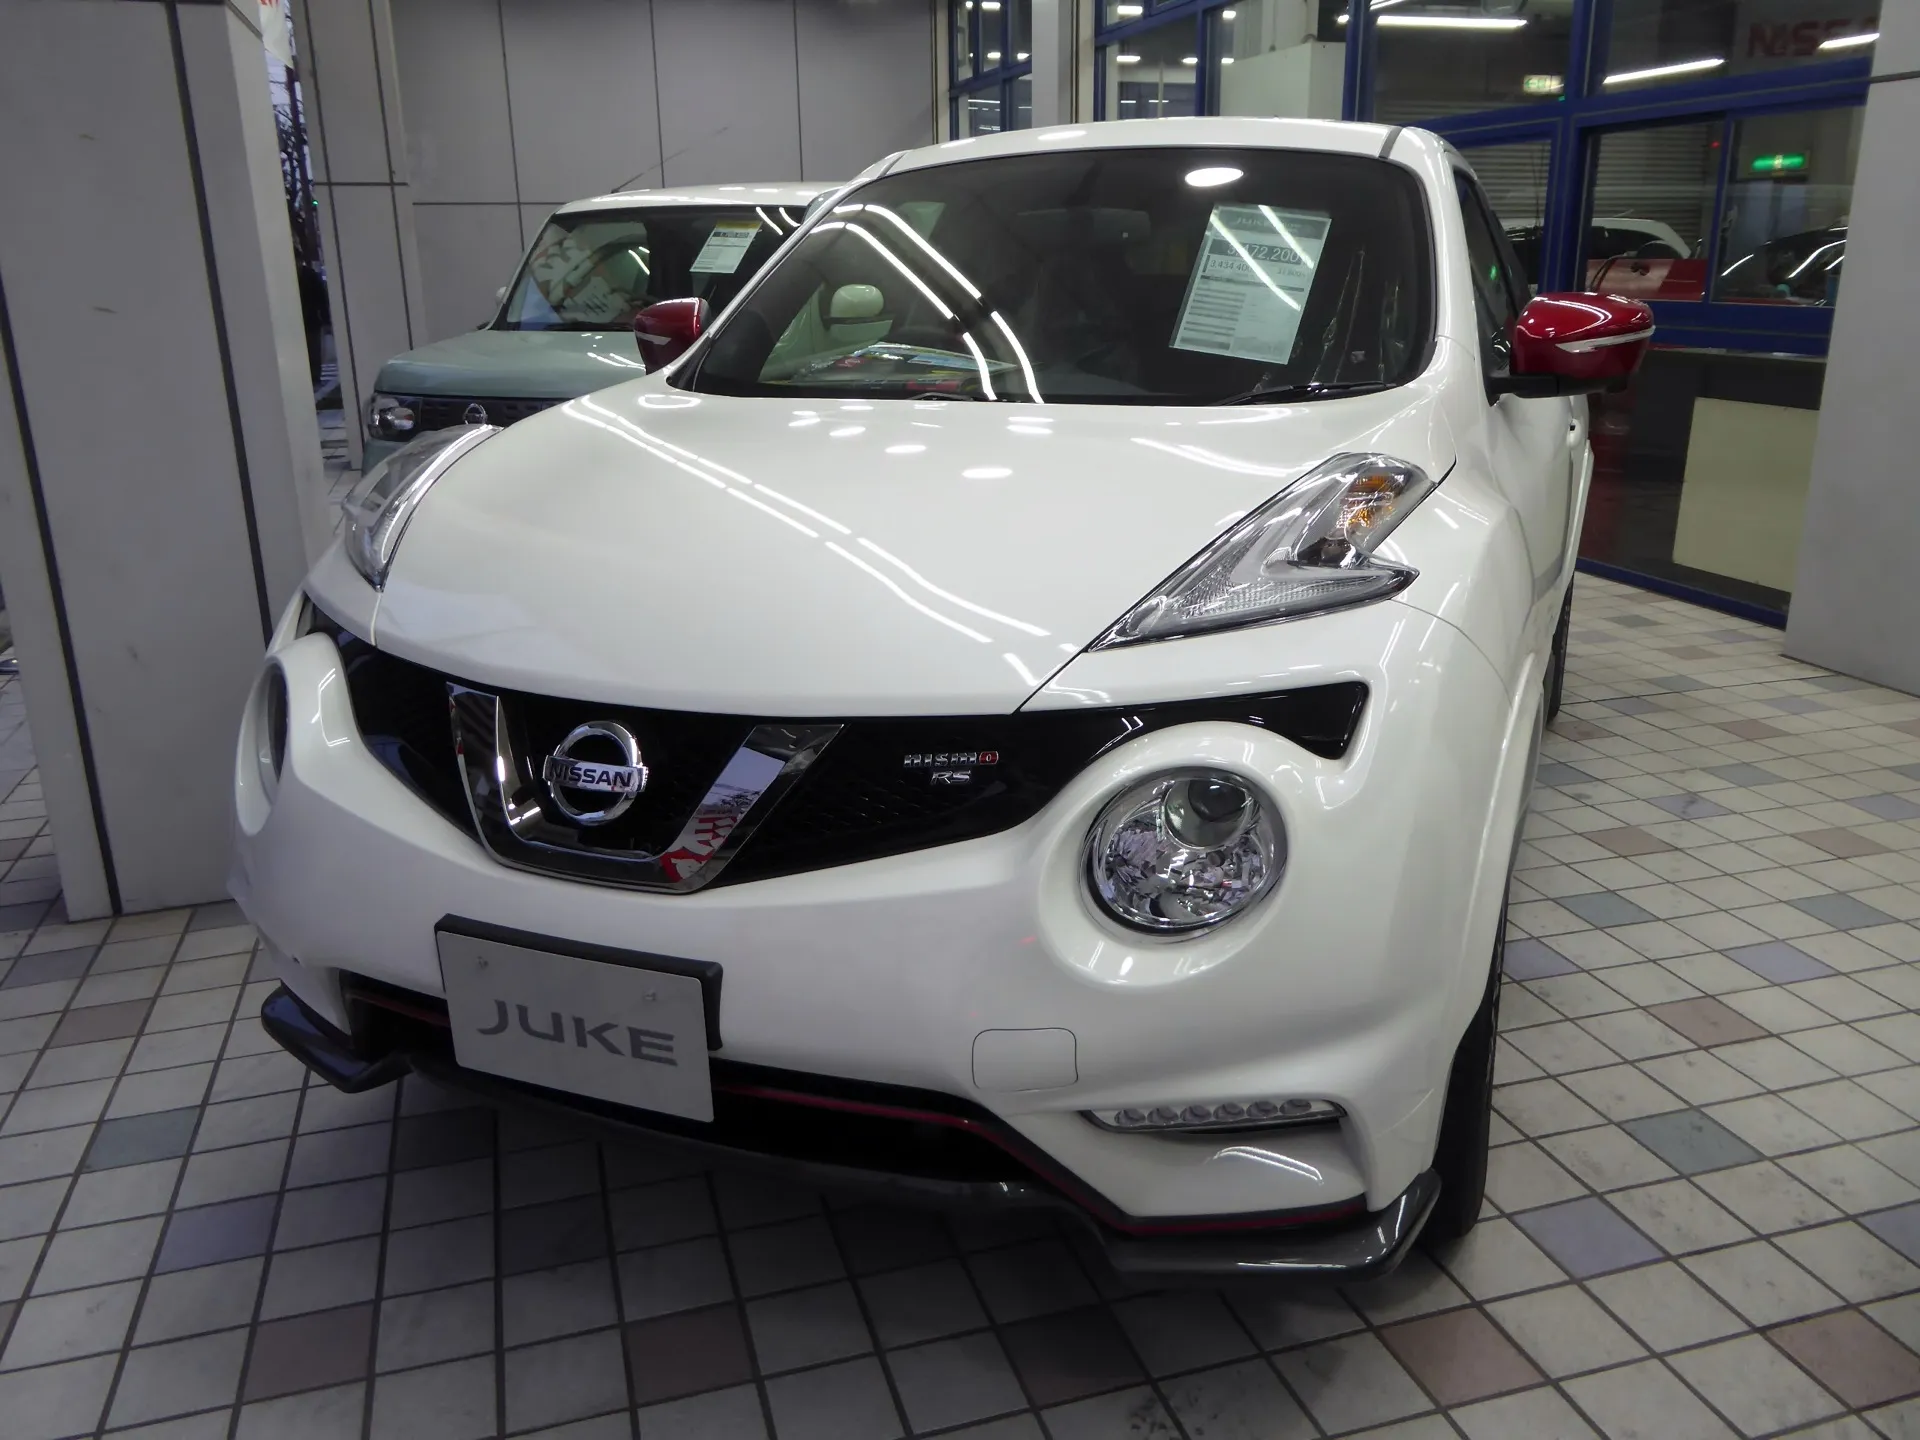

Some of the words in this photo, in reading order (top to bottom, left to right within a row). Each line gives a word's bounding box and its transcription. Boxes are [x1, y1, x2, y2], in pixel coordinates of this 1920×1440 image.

[549, 761, 632, 788] NISSAN
[930, 769, 971, 785] RS
[476, 999, 678, 1067] JUKE
